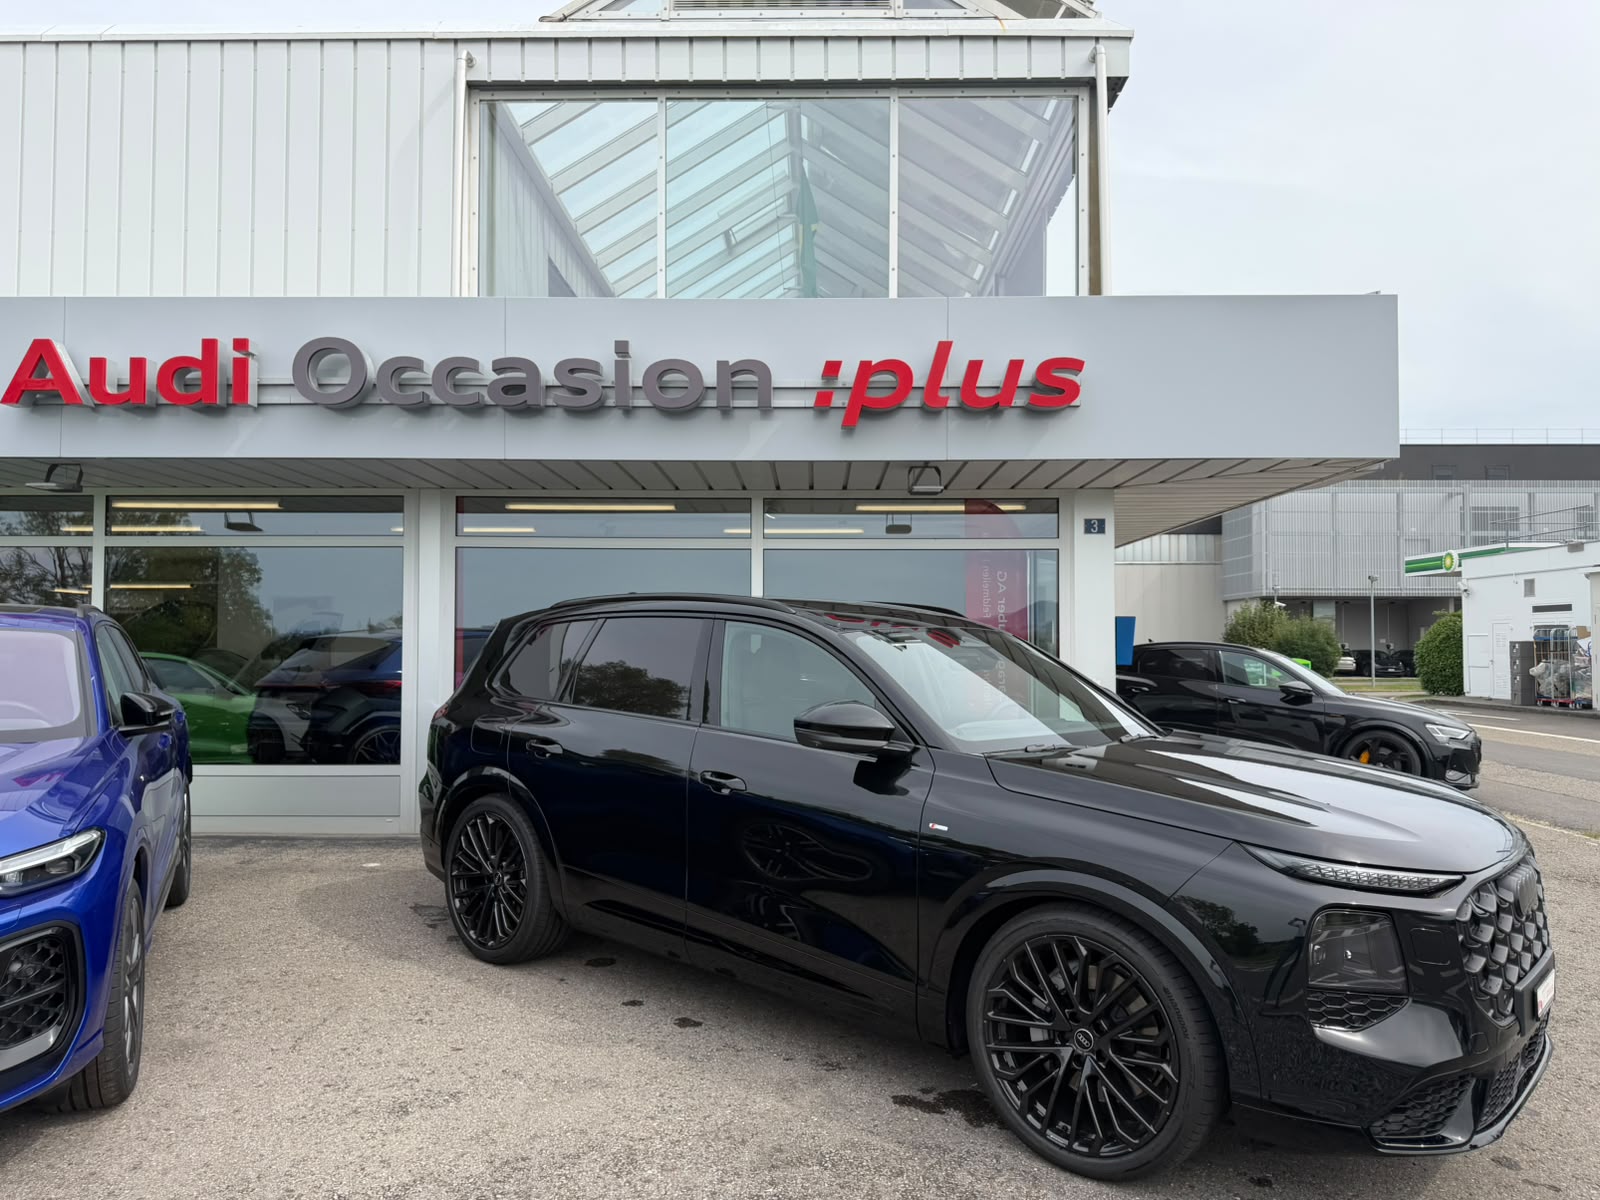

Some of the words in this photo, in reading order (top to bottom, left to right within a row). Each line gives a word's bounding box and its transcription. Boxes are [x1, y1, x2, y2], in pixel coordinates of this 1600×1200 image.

[1, 338, 252, 406] Audi
[292, 337, 773, 409] Occasion
[1090, 519, 1098, 533] 3
